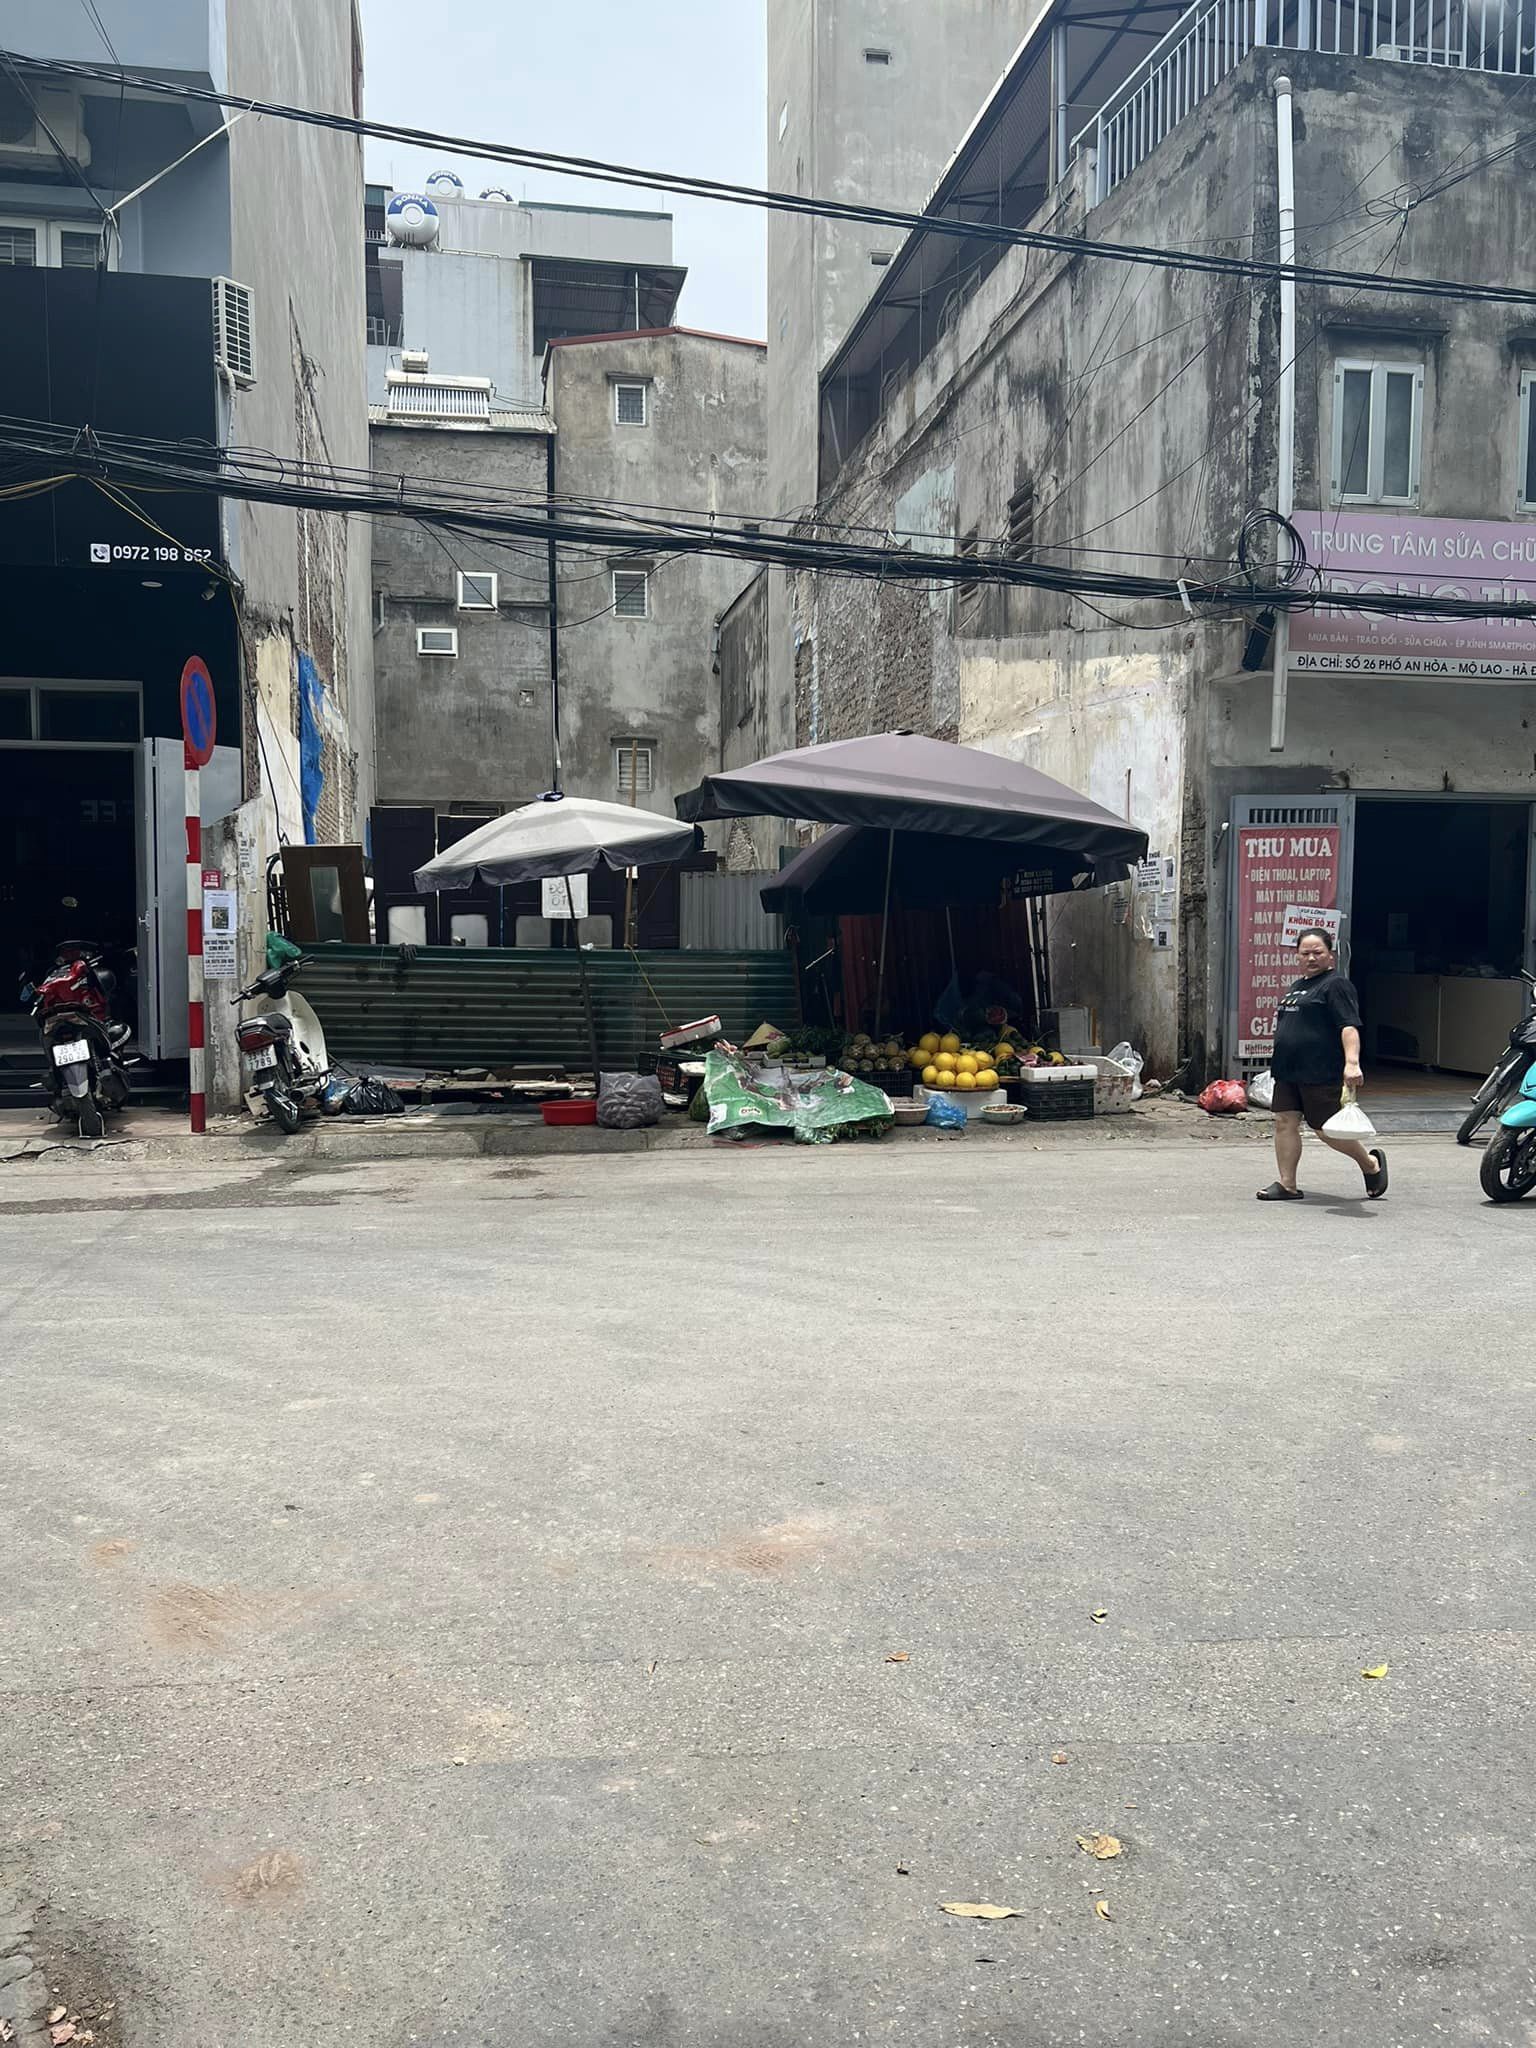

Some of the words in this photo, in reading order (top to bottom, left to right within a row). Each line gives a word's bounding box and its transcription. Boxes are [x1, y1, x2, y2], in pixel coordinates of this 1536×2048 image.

[113, 545, 150, 560] 0972
[153, 547, 179, 561] 198
[1311, 530, 1385, 554] TRUNG
[1391, 531, 1437, 557] TÂM
[1443, 531, 1486, 560] SỬA
[1308, 632, 1328, 642] MUA
[1356, 635, 1378, 645] TRAO
[1488, 640, 1536, 651] SMARTPHO
[1297, 654, 1317, 668] ĐỊA
[1320, 655, 1342, 668] CHỈ:
[1345, 656, 1361, 669] SỐ
[1363, 659, 1376, 670] 26
[1379, 657, 1401, 671] PHỐ
[1404, 661, 1421, 672] AN
[1423, 658, 1448, 673] HÒA
[1458, 661, 1478, 675] MỘ
[1480, 664, 1503, 675] LAO
[1512, 663, 1528, 676] HÀ
[1245, 838, 1285, 858] THU
[1289, 837, 1333, 857] MUA
[1300, 868, 1332, 882] LAPTOP,
[1256, 888, 1275, 903] MÁY
[1276, 887, 1296, 903] TÍNH
[1326, 921, 1336, 929] XE
[1252, 975, 1279, 989] APPLE,
